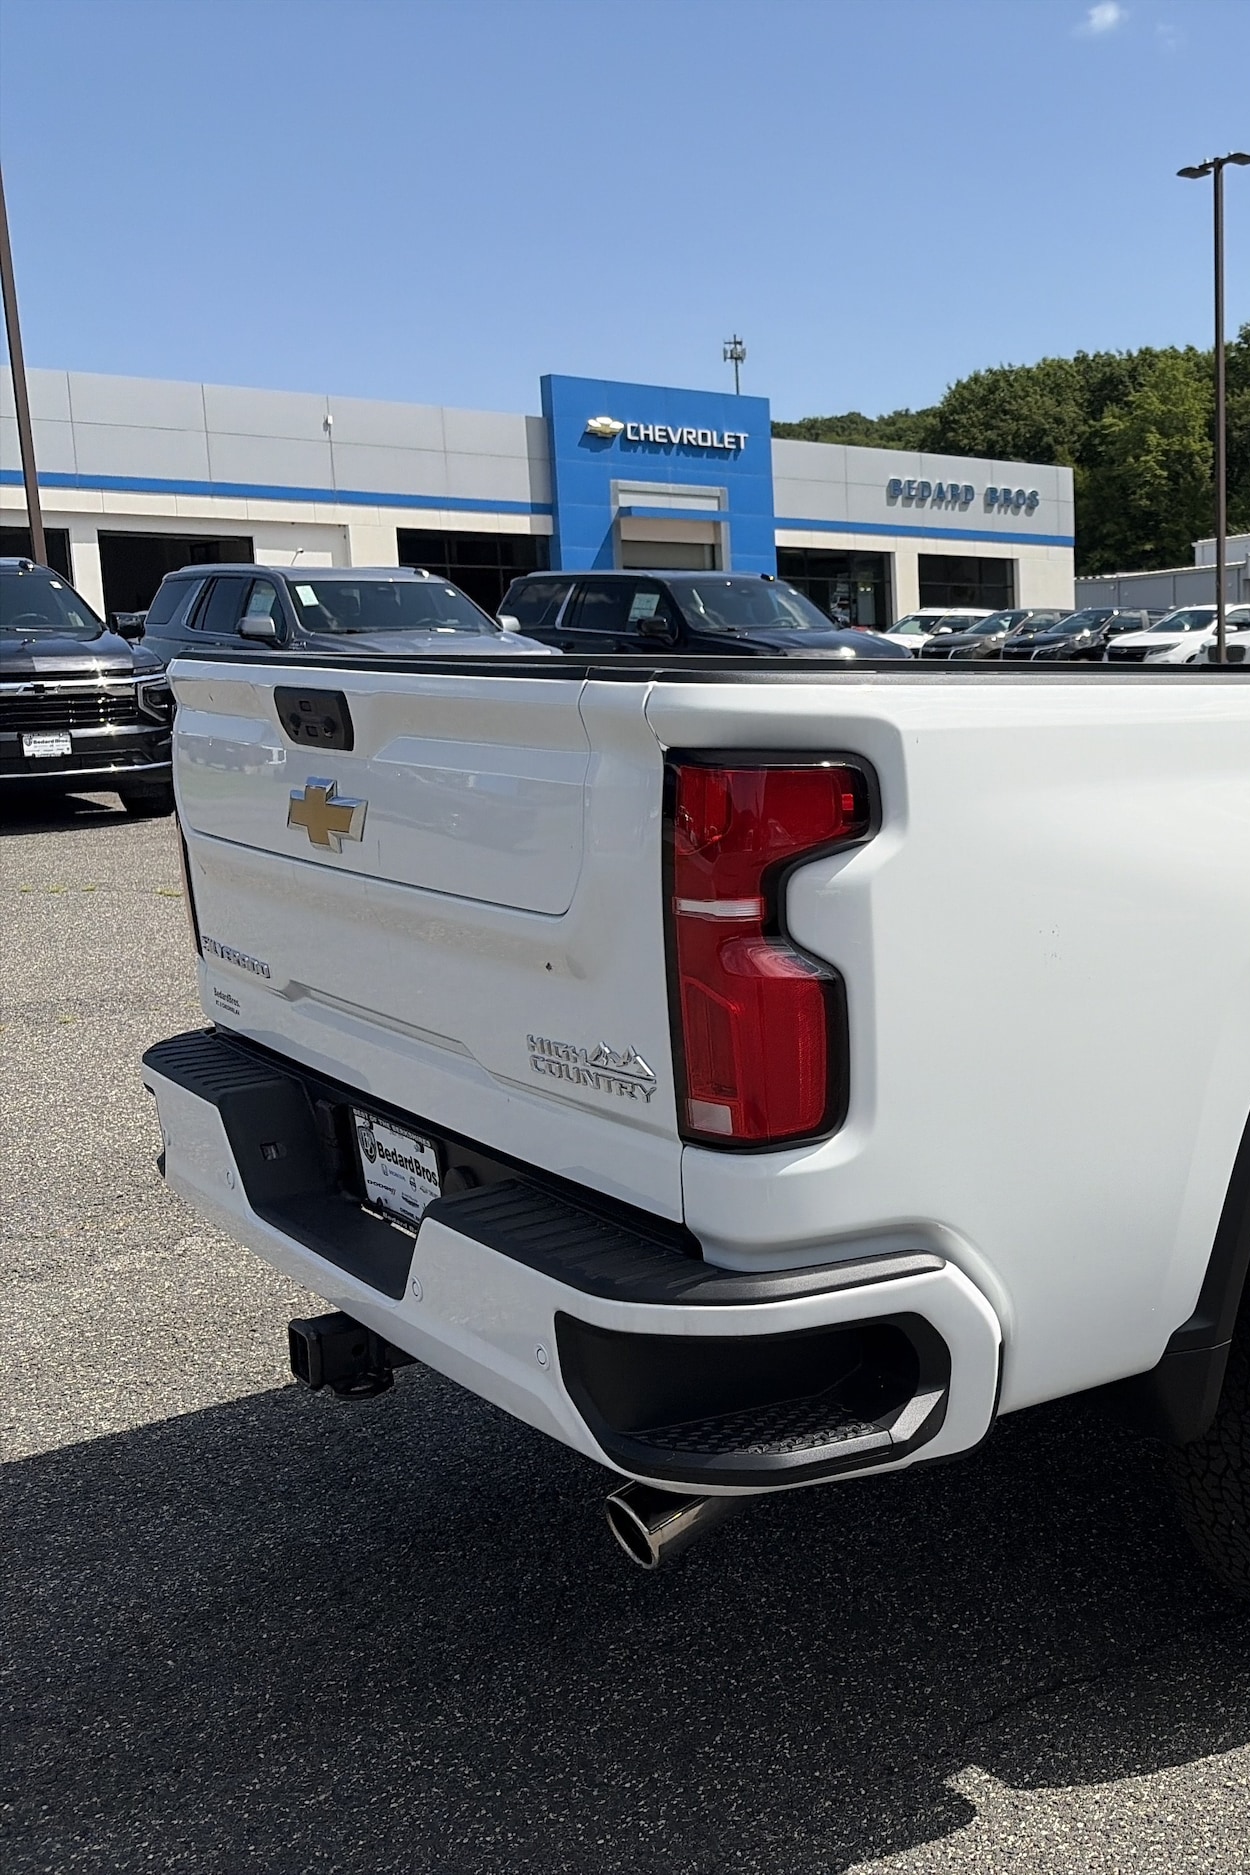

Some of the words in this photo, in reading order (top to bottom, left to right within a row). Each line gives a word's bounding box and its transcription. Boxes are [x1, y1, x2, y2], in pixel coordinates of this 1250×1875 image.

[626, 422, 749, 450] CHEVROLET
[888, 478, 976, 504] BEDARD
[984, 486, 1040, 510] BROS
[526, 1033, 590, 1067] HIGH
[529, 1054, 657, 1104] COUNTRY
